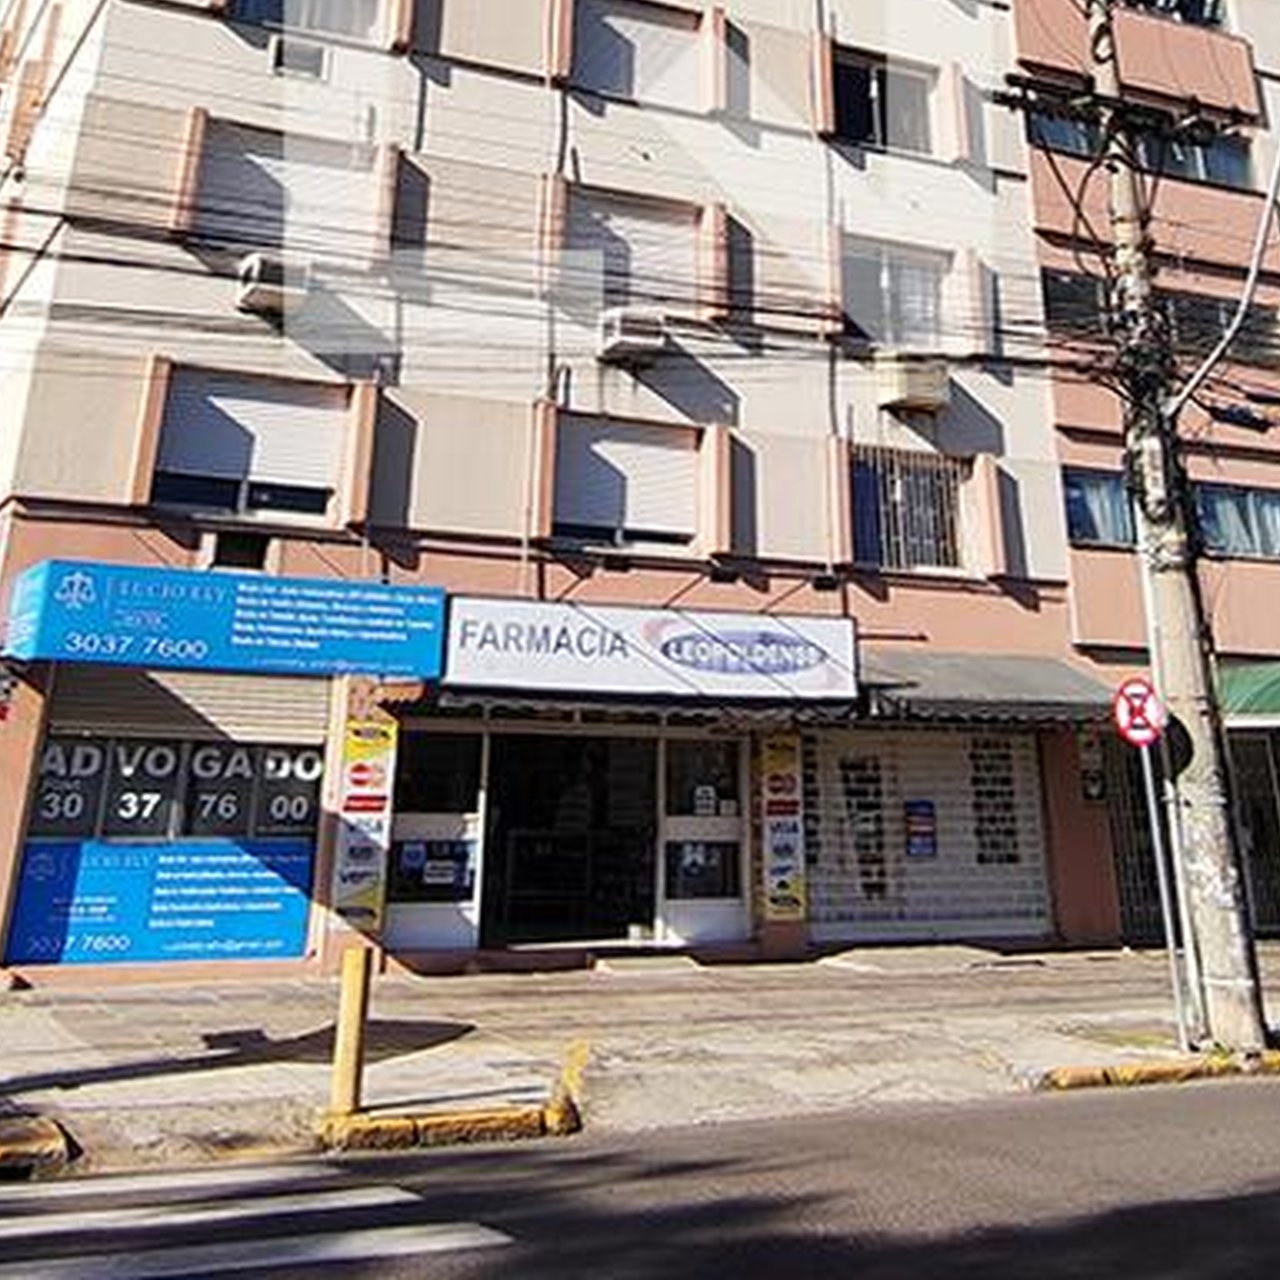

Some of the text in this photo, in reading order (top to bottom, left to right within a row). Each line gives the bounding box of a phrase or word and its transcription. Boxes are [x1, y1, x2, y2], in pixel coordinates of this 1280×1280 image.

[65, 631, 208, 659] 3037 7600
[459, 614, 630, 658] FARMÁCIA
[81, 933, 132, 952] 7600
